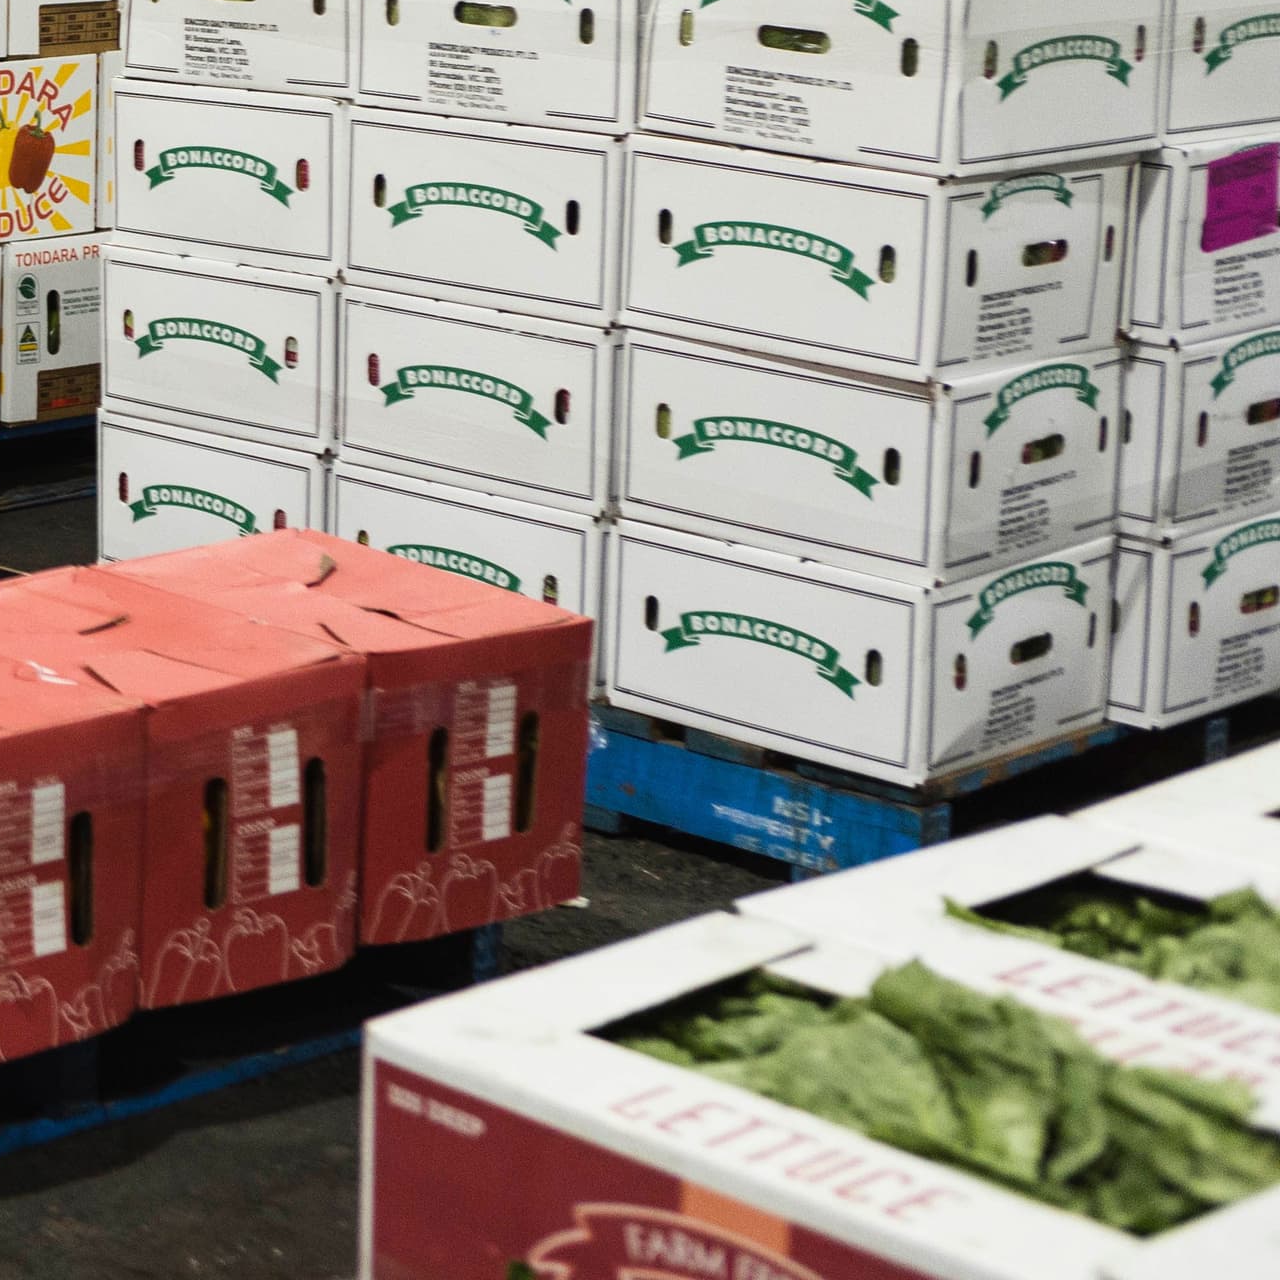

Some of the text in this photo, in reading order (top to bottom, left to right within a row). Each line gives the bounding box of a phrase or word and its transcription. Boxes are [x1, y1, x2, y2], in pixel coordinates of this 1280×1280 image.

[1019, 37, 1114, 59] BONACCORD
[166, 150, 267, 178] BONACCORD
[414, 185, 534, 216] BONACCORD
[16, 243, 78, 267] TONDARA
[703, 224, 842, 263] BONACCORD
[155, 320, 257, 352] BONACCORD
[405, 367, 523, 407] BONACCORD
[1003, 368, 1081, 399] BONACCORD
[703, 421, 845, 461] BONACCORD
[149, 487, 248, 523] BONACCORD
[400, 547, 511, 587] BONACCORD
[985, 568, 1071, 605] BONACCORD
[690, 613, 829, 662] BONACCORD
[609, 1085, 966, 1219] LETTUCE
[623, 1222, 726, 1276] FARM
